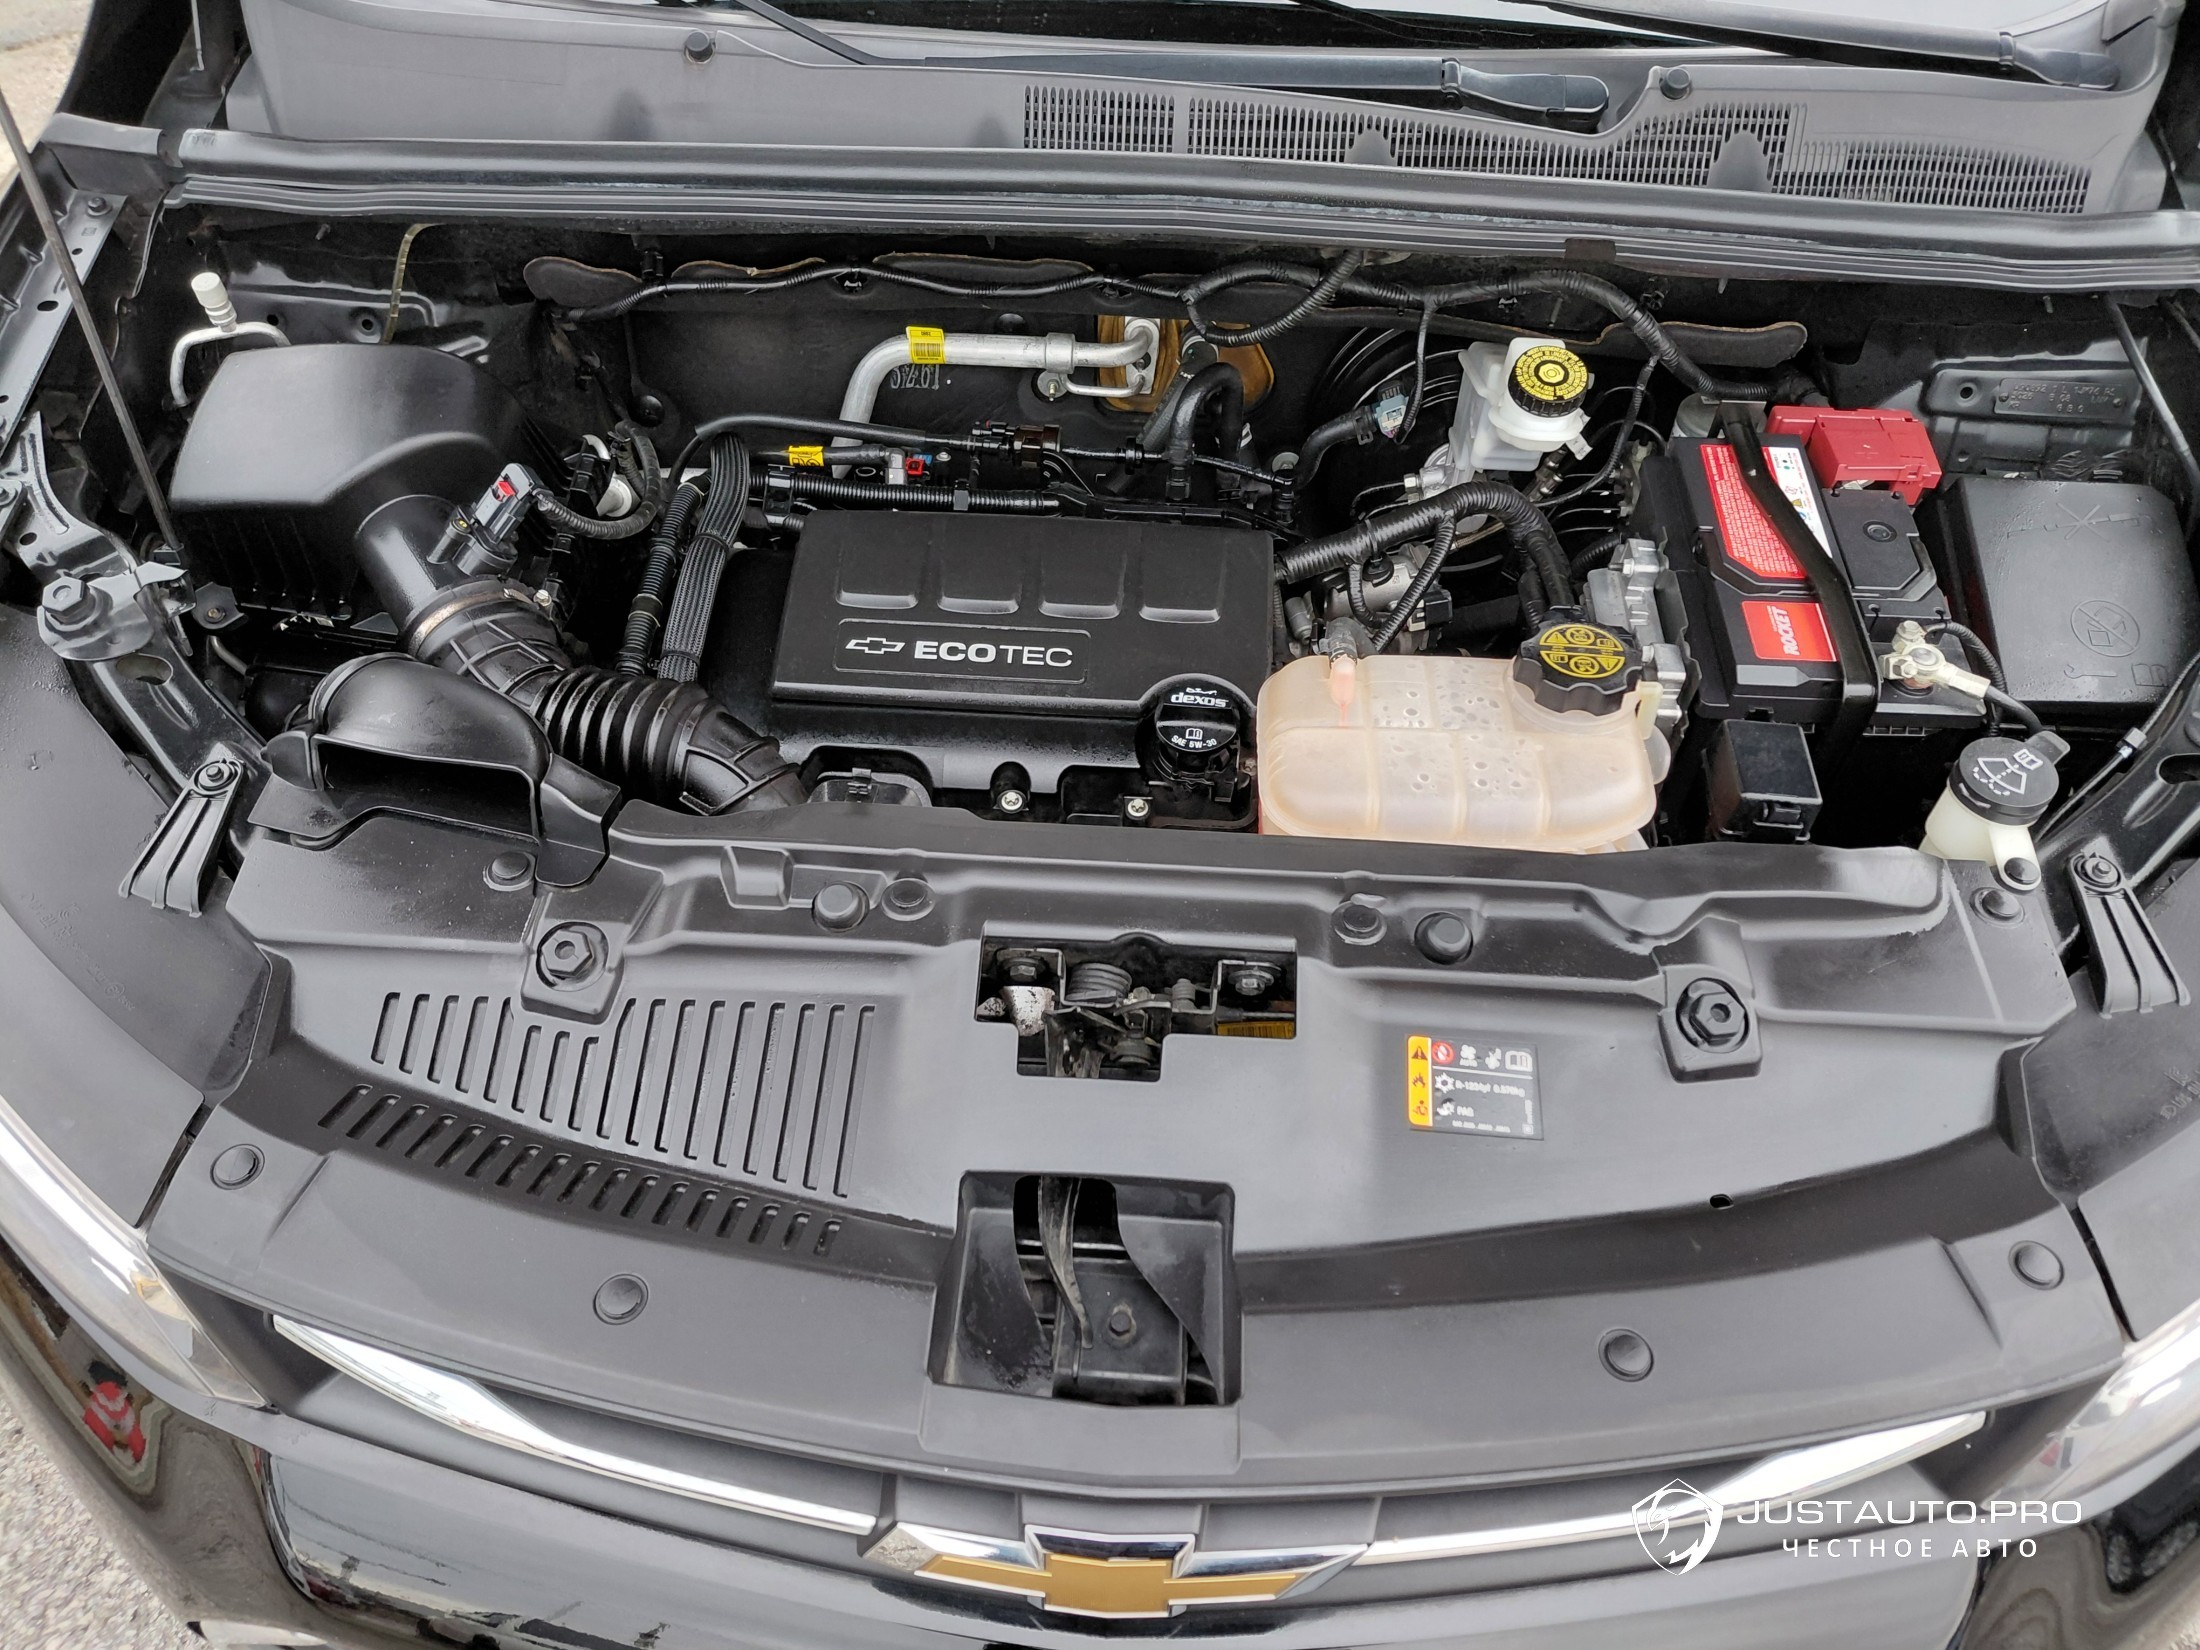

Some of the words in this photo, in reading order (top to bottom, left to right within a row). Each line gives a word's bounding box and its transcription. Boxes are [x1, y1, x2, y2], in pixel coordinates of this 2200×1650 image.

[1772, 606, 1800, 656] ROCKET
[914, 640, 1073, 667] ECOTEC
[1170, 692, 1229, 708] dexos
[1171, 735, 1187, 747] SAE
[1189, 738, 1217, 748] 5W-30
